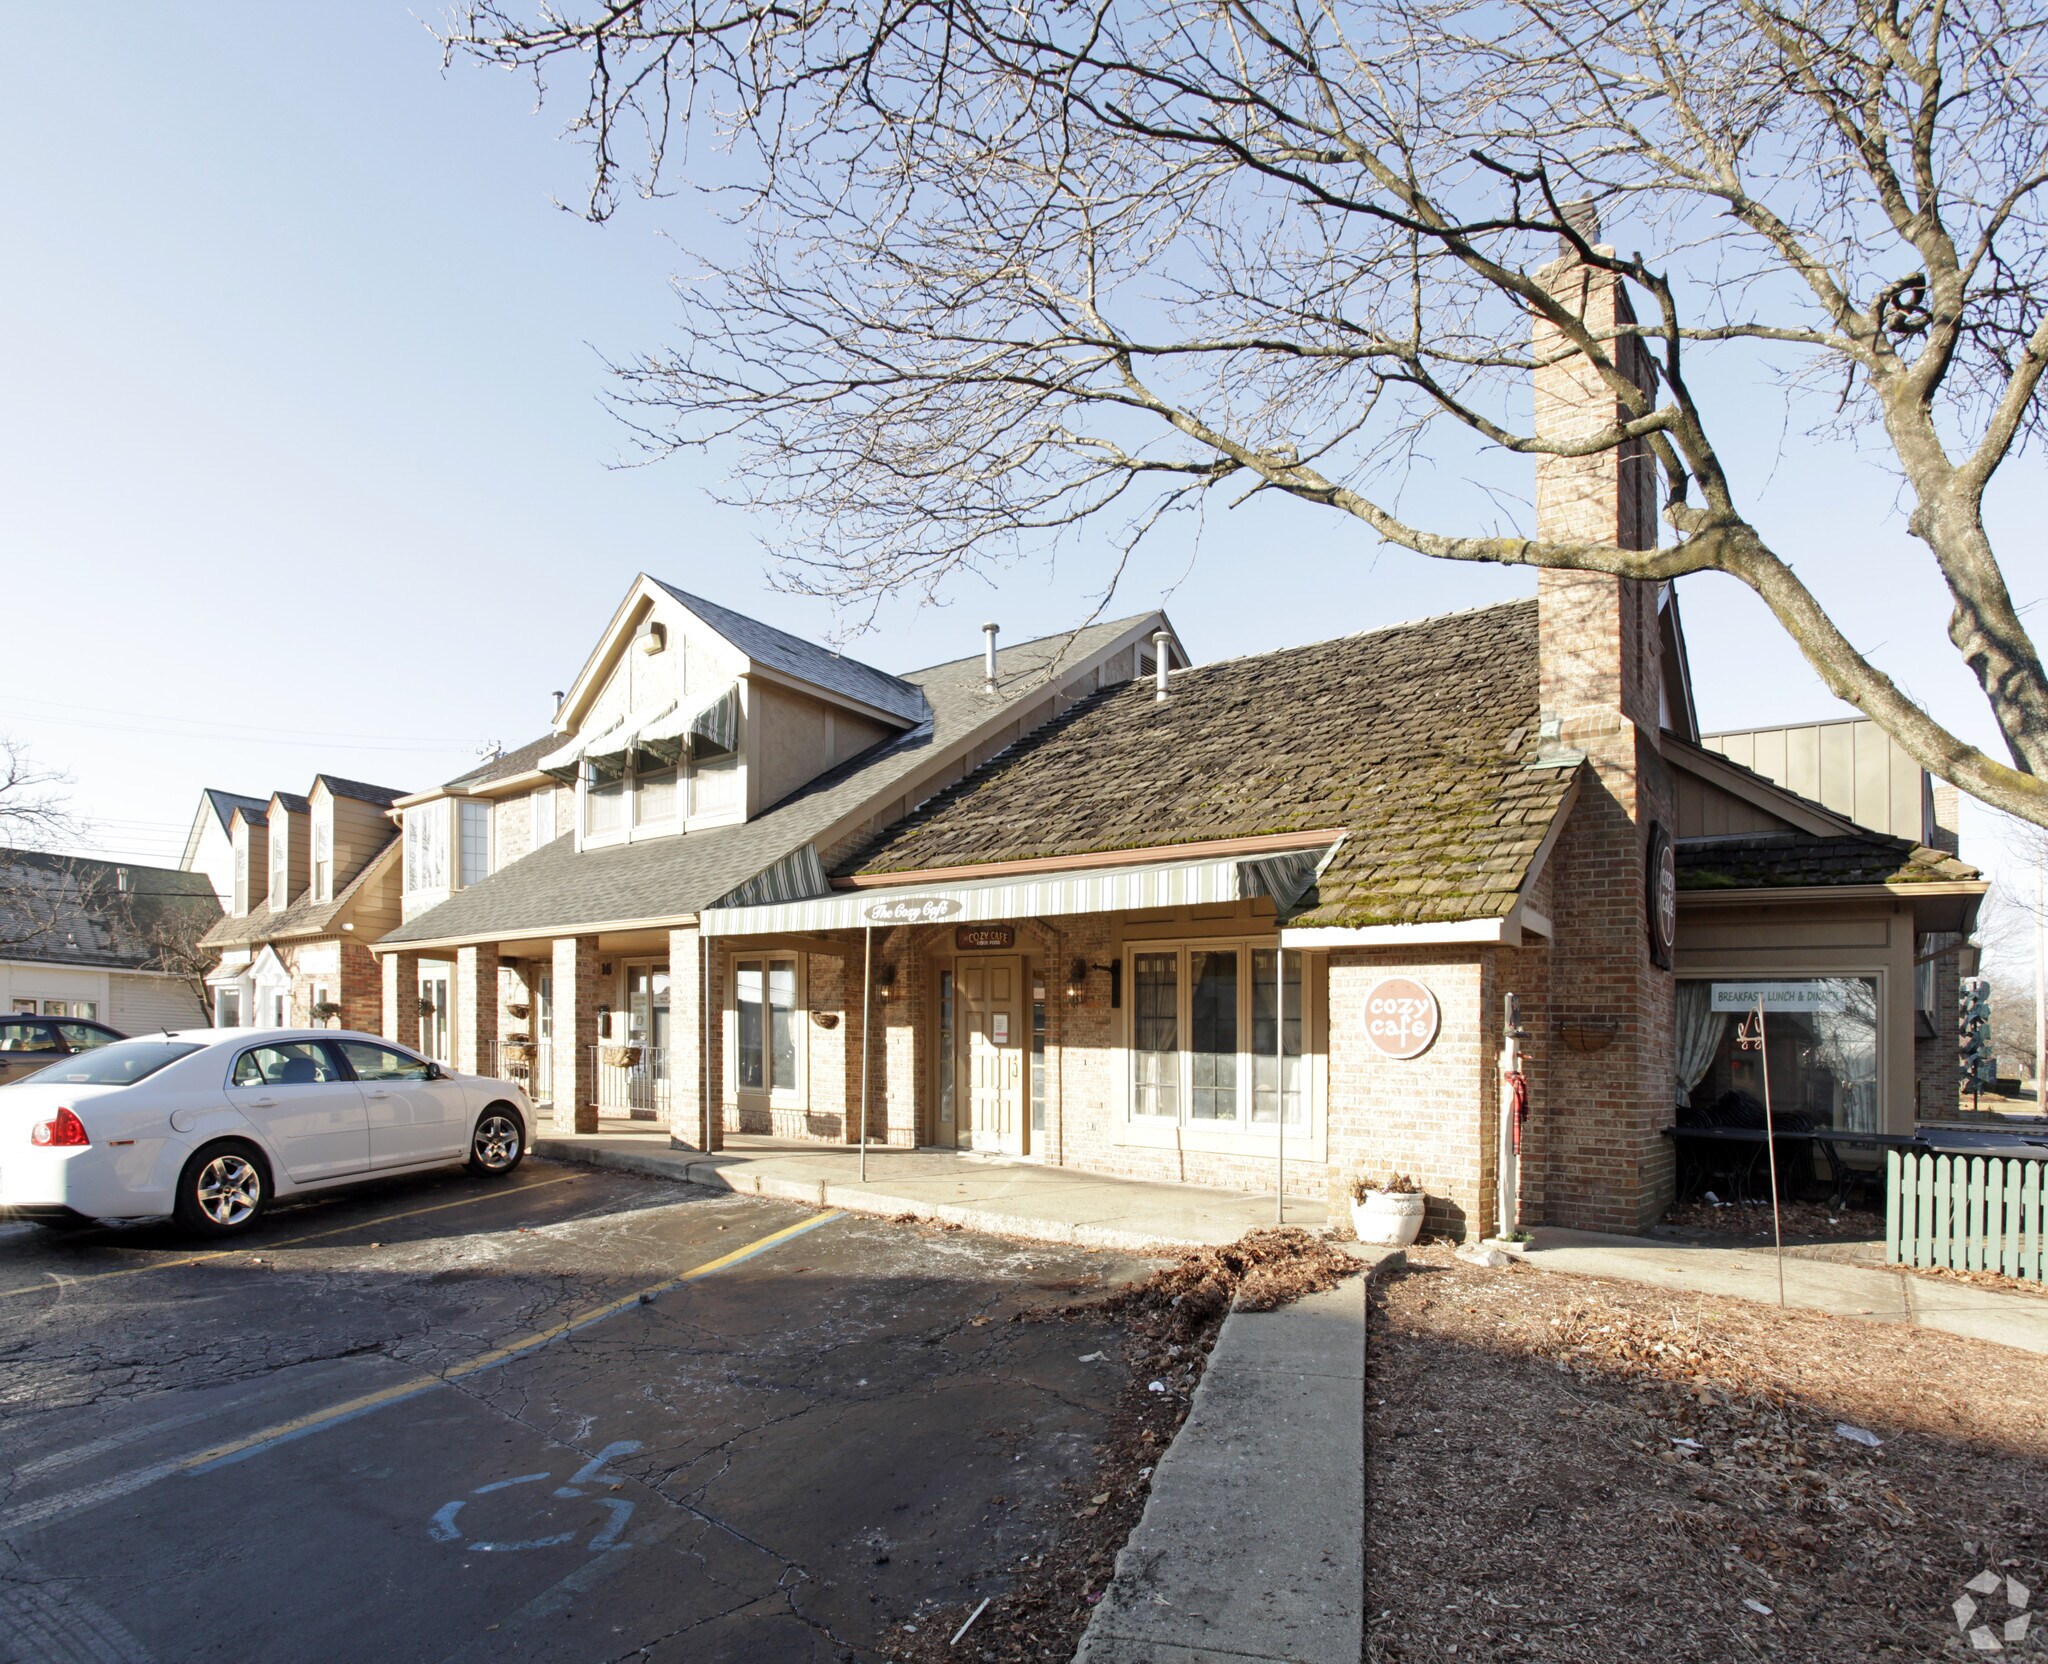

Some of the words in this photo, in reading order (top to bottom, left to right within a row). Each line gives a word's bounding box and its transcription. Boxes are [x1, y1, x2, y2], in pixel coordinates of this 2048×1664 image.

[872, 905, 893, 919] The
[895, 903, 920, 921] Cozy
[968, 932, 989, 943] COZY
[991, 931, 1008, 943] CAFE
[1767, 991, 1795, 1002] LUNCH
[1797, 991, 1805, 1002] &
[1370, 998, 1429, 1018] cozy
[1370, 1013, 1428, 1048] cafe
